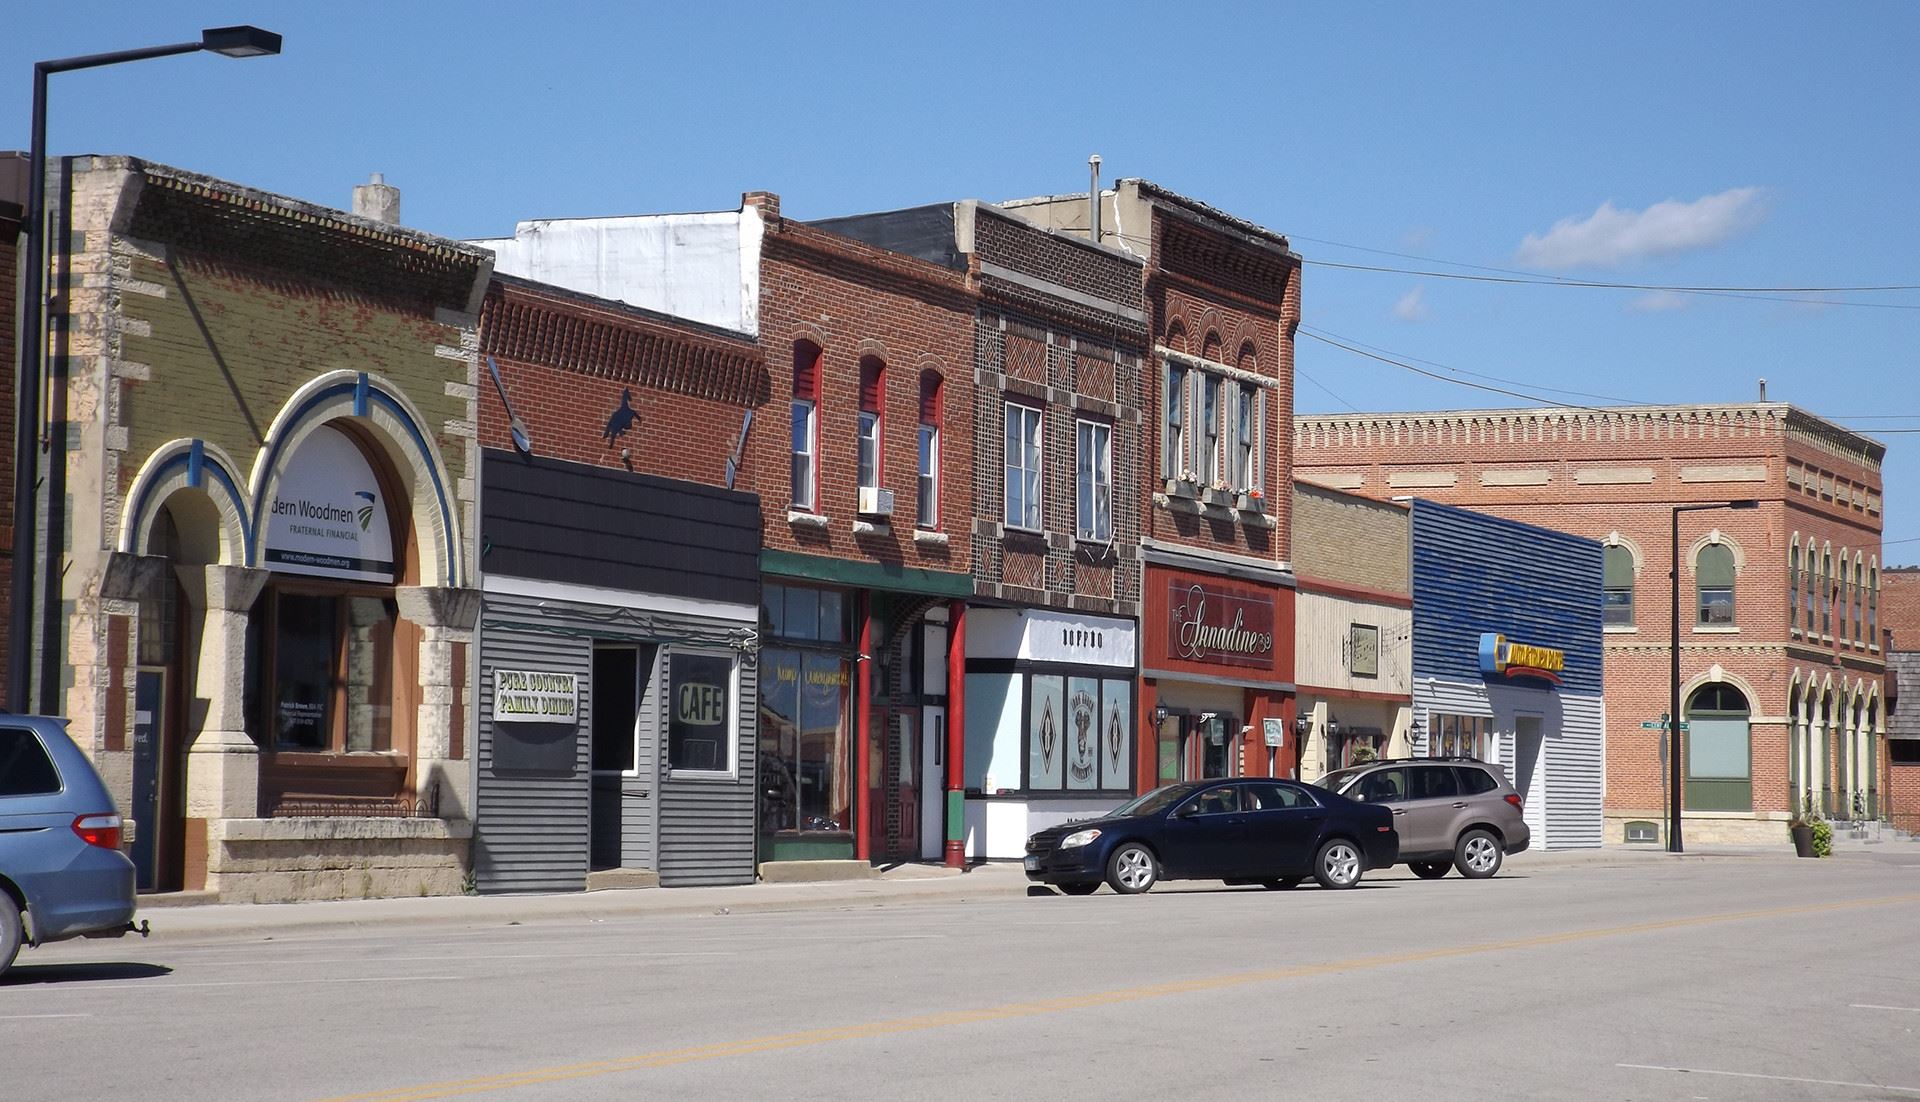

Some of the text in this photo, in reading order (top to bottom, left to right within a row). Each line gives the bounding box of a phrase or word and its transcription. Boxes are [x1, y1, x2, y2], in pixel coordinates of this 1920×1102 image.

[271, 496, 353, 523] dern Woodmen
[289, 524, 358, 542] FRATERNAL FINANCIAL
[280, 552, 350, 568] www.modern-woodmen.org
[1172, 585, 1258, 658] THE Annadine
[499, 671, 574, 693] PURE COUNTRY
[500, 695, 574, 716] FAMILY DINING
[680, 685, 722, 722] CAFE
